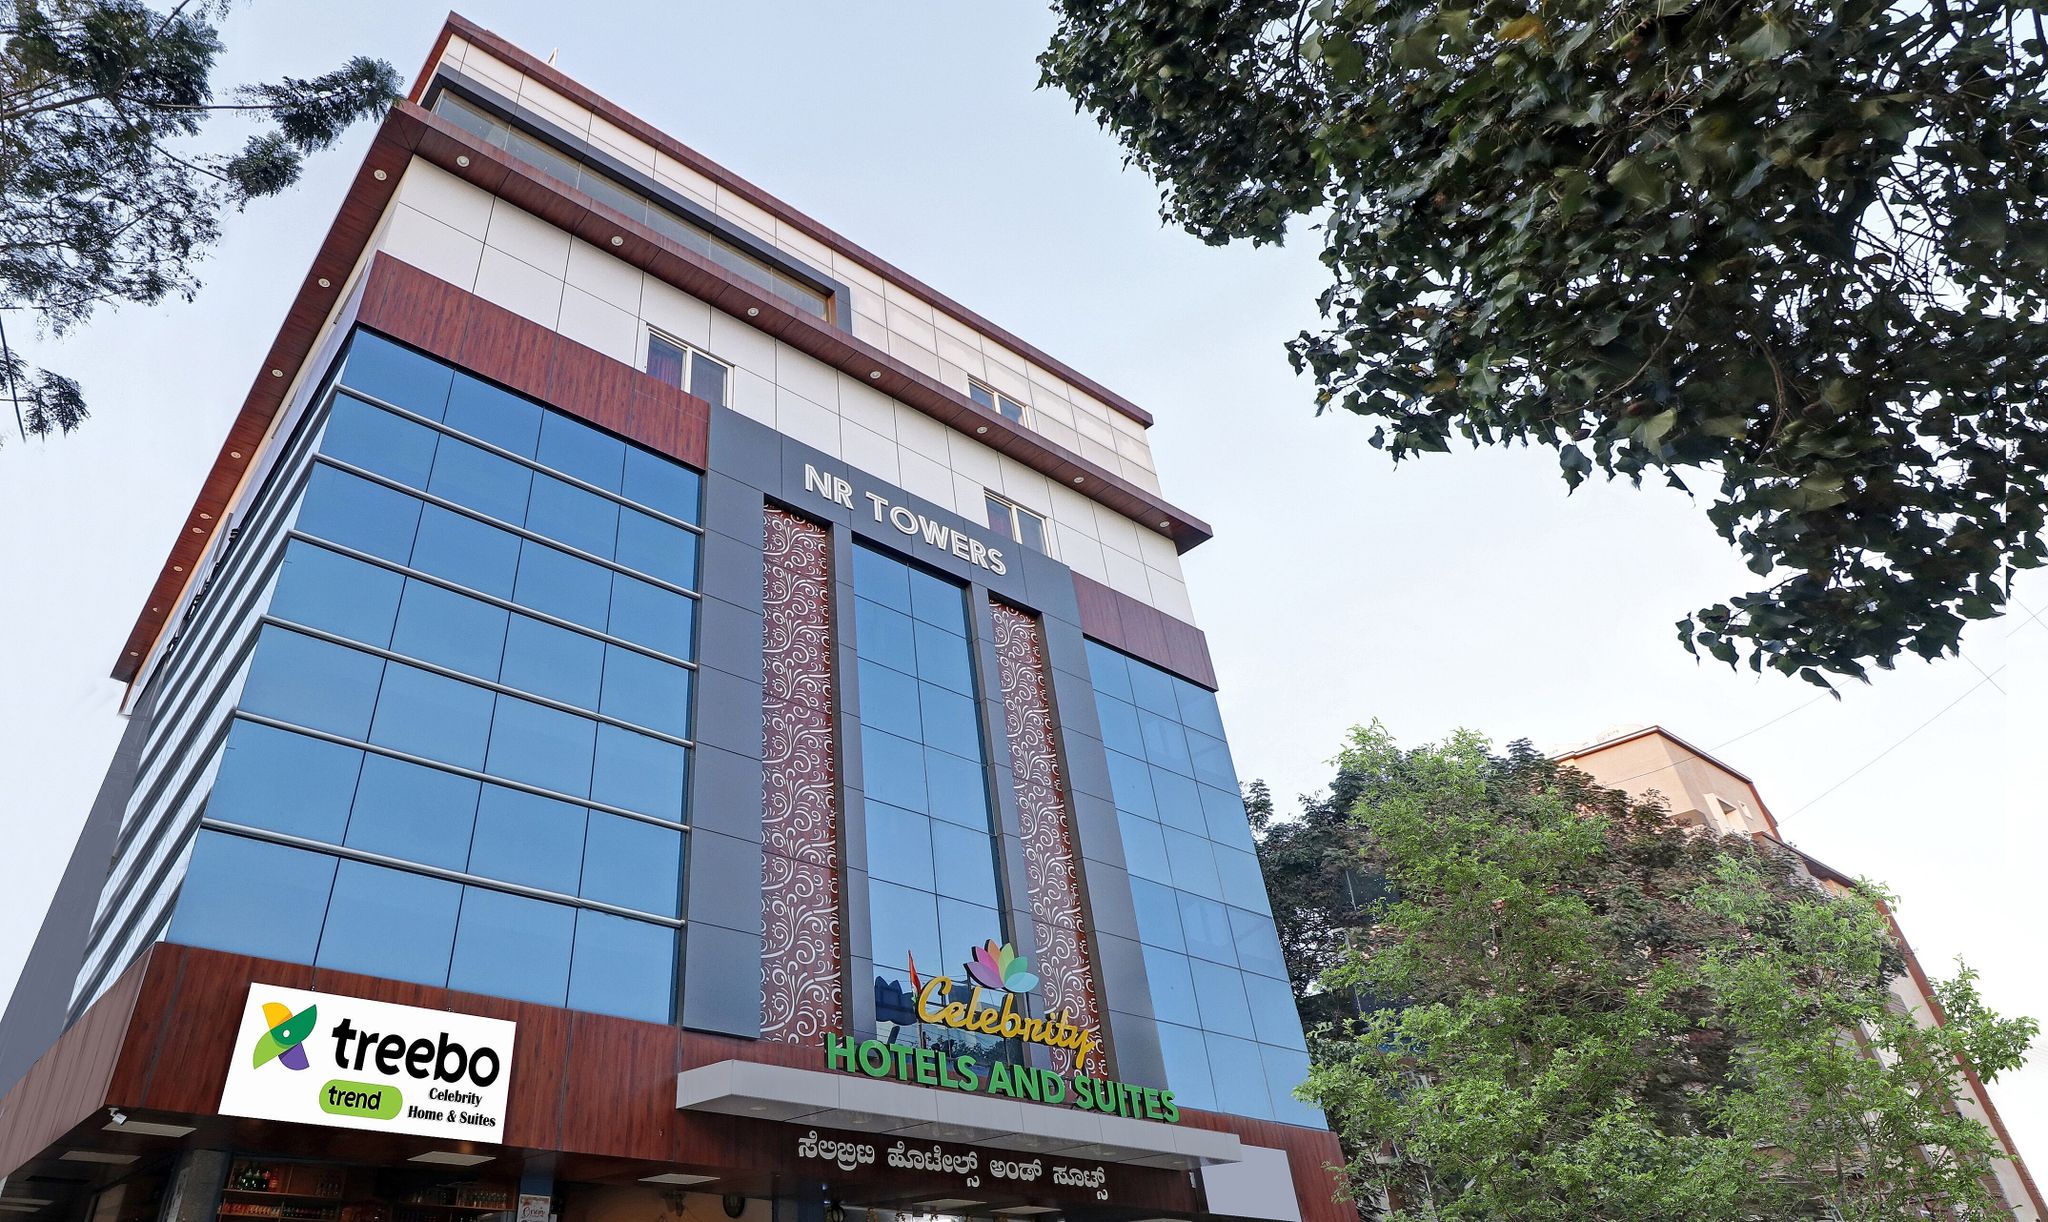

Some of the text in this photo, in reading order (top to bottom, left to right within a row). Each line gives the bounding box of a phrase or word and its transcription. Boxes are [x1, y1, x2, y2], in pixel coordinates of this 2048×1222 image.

[803, 463, 1007, 576] NR TOWERS
[917, 975, 1095, 1069] Celebrity
[332, 1018, 500, 1087] treebo
[328, 1085, 382, 1110] trend
[429, 1087, 482, 1108] Celebrity
[825, 1031, 1180, 1123] HOTELS AND SUITES
[407, 1105, 496, 1128] Home & Suites
[990, 1158, 1043, 1182] ಅಂಡ್
